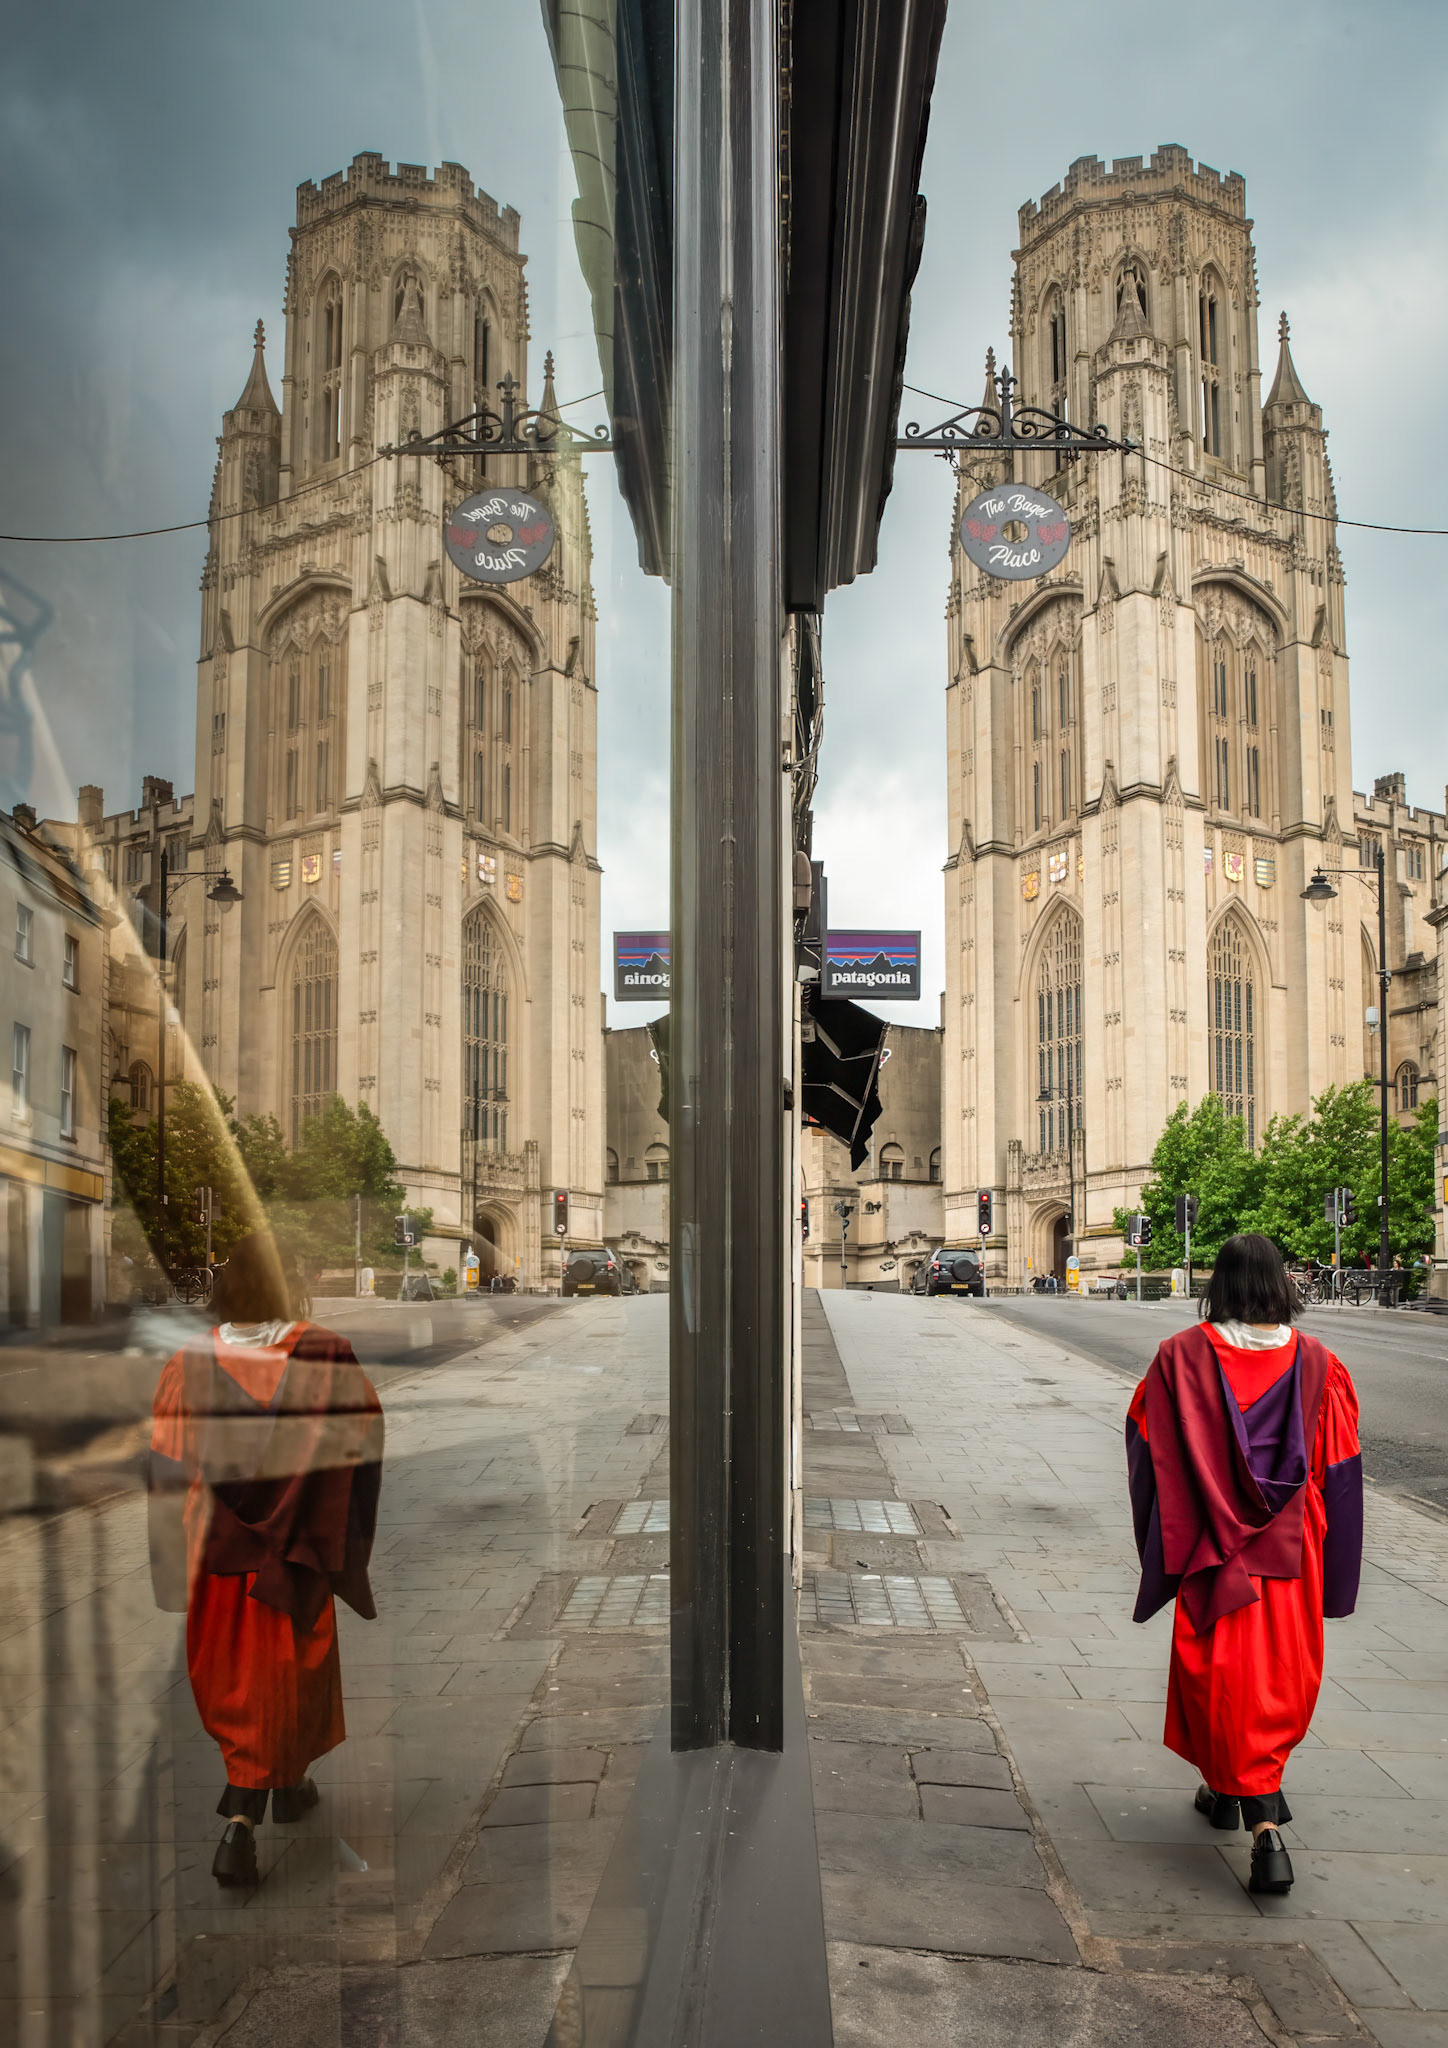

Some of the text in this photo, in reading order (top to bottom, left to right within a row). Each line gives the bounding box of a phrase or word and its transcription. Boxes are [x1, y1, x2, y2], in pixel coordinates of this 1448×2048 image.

[979, 494, 1053, 518] The Bagel
[989, 545, 1040, 567] Place
[831, 971, 911, 987] patagonia
